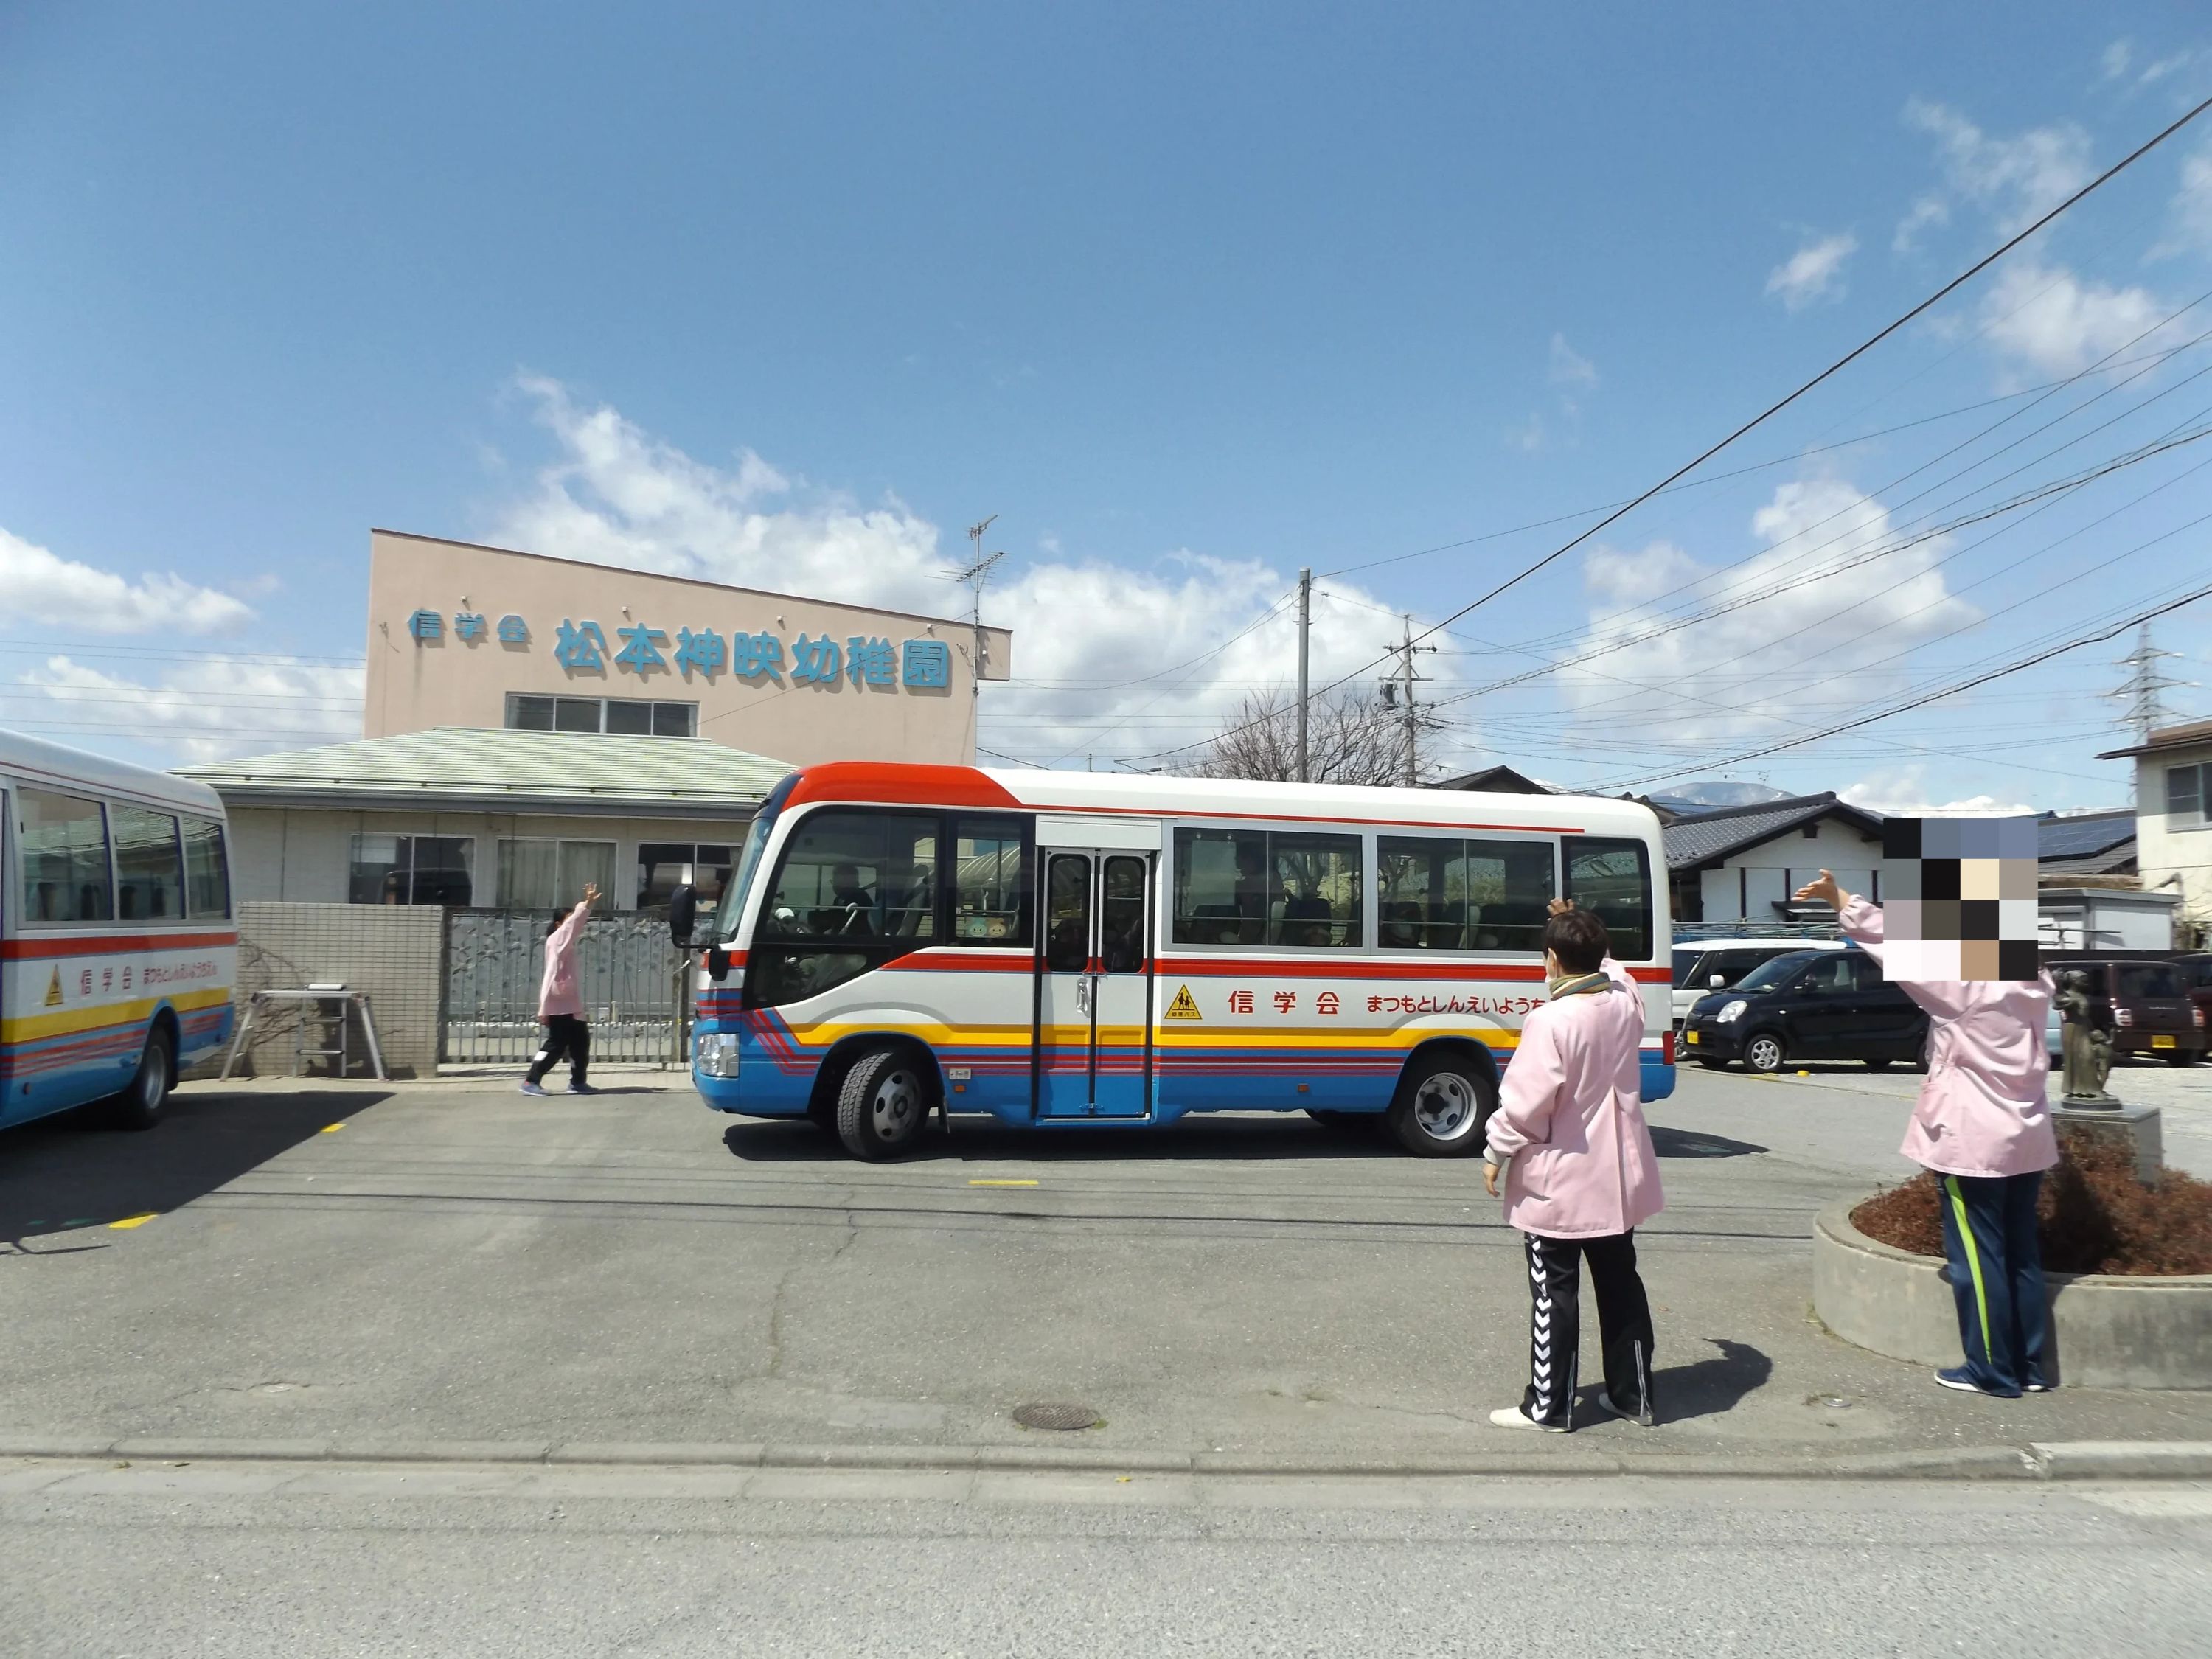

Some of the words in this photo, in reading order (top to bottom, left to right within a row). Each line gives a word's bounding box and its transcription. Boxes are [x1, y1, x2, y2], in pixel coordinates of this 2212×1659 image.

[407, 609, 526, 643] 信学会
[554, 618, 948, 687] 松本神映幼稚園
[80, 966, 133, 995] 信学会
[1228, 990, 1340, 1015] 信学会
